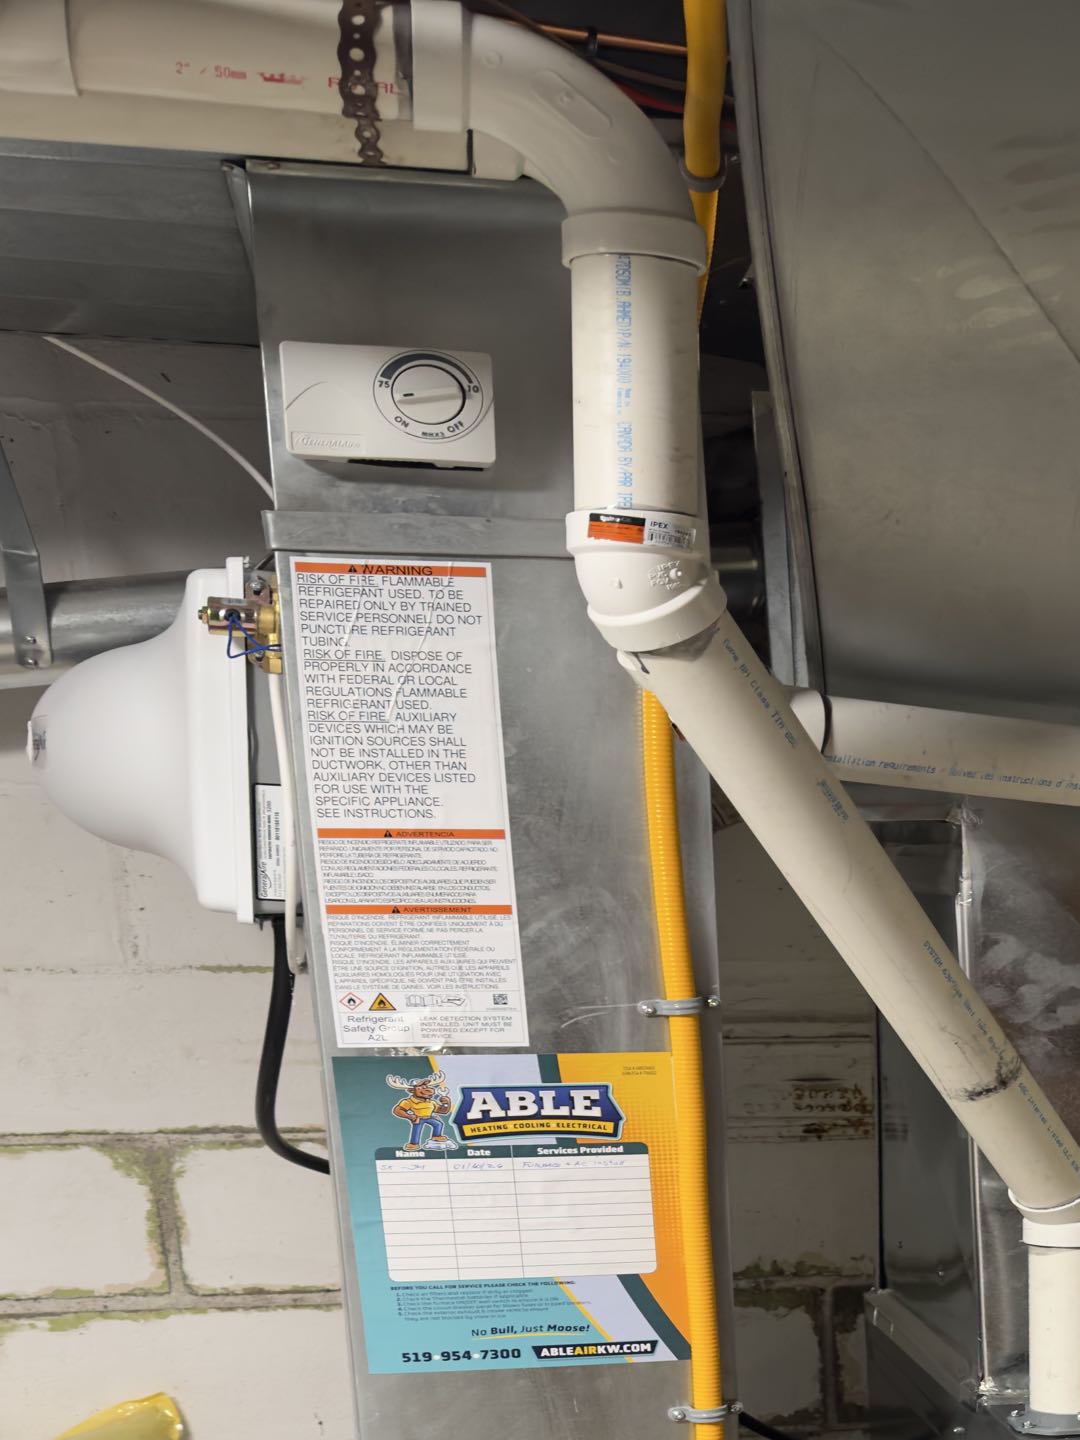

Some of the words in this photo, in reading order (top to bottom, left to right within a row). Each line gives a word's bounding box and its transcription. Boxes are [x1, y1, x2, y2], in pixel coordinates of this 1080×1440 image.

[378, 380, 390, 389] 75
[394, 416, 410, 428] ON
[447, 420, 464, 434] OFF
[650, 521, 668, 529] IPEX
[362, 564, 433, 575] WARNING
[297, 573, 325, 584] RISK
[328, 574, 345, 584] OF
[382, 576, 454, 587] FLAMMABLE
[299, 586, 384, 598] REFRIGERANT
[428, 590, 445, 599] TO
[448, 590, 463, 600] BE
[300, 599, 360, 610] REPAIRED
[363, 601, 397, 611] ONLY
[400, 602, 416, 611] BY
[421, 602, 472, 612] TRAINED
[300, 611, 351, 622] SERVICE
[436, 615, 454, 624] DO
[458, 615, 482, 625] NOT
[372, 626, 456, 637] REFRIGERANT
[304, 649, 331, 658] RISK
[334, 649, 350, 659] OF
[391, 651, 443, 661] DISPOSE
[446, 651, 463, 661] OF
[304, 661, 368, 672] PROPERLY
[372, 662, 385, 672] IN
[388, 663, 472, 674] ACCORDANCE
[304, 674, 336, 683] WITH
[339, 674, 394, 685] FEDERAL
[398, 676, 415, 685] OR
[418, 676, 458, 686] LOCAL
[306, 686, 392, 697] REGULATIONS
[395, 688, 467, 698] FLAMMABLE
[307, 699, 391, 709] REFRIGERANT
[308, 711, 335, 720] RISK
[338, 711, 355, 721] OF
[395, 712, 457, 722] AUXILIARY
[309, 723, 361, 733] DEVICES
[364, 724, 405, 734] WHICH
[408, 724, 434, 734] MAY
[438, 724, 453, 734] BE
[309, 736, 363, 746] IGNITION
[367, 736, 426, 746] SOURCES
[430, 737, 467, 747] SHALL
[310, 748, 335, 758] NOT
[340, 748, 355, 758] BE
[359, 748, 424, 758] INSTALLED
[428, 749, 439, 758] IN
[443, 749, 466, 759] THE
[389, 760, 431, 770] OTHER
[434, 761, 467, 771] THAN
[313, 772, 375, 782] AUXILIARY
[379, 772, 431, 782] DEVICES
[434, 773, 476, 783] LISTED
[314, 784, 339, 794] FOR
[343, 784, 367, 794] USE
[371, 784, 401, 794] WITH
[405, 785, 428, 794] THE
[315, 796, 370, 806] SPECIFIC
[374, 797, 444, 807] APPLIANCE.
[317, 808, 340, 818] SEE
[343, 1024, 375, 1033] Safety
[466, 1089, 602, 1120] ABLE
[470, 1124, 508, 1133] HEATING
[556, 1122, 608, 1130] ELECTRICAL
[395, 1150, 426, 1158] Name
[467, 1149, 492, 1157] Date
[537, 1147, 578, 1155] Services
[580, 1146, 624, 1154] Provided
[471, 1328, 487, 1337] No
[490, 1326, 517, 1335] Bull,
[520, 1324, 543, 1334] Just
[547, 1324, 590, 1333] Moose!
[540, 1342, 651, 1357] ABLEAIRKW.COM
